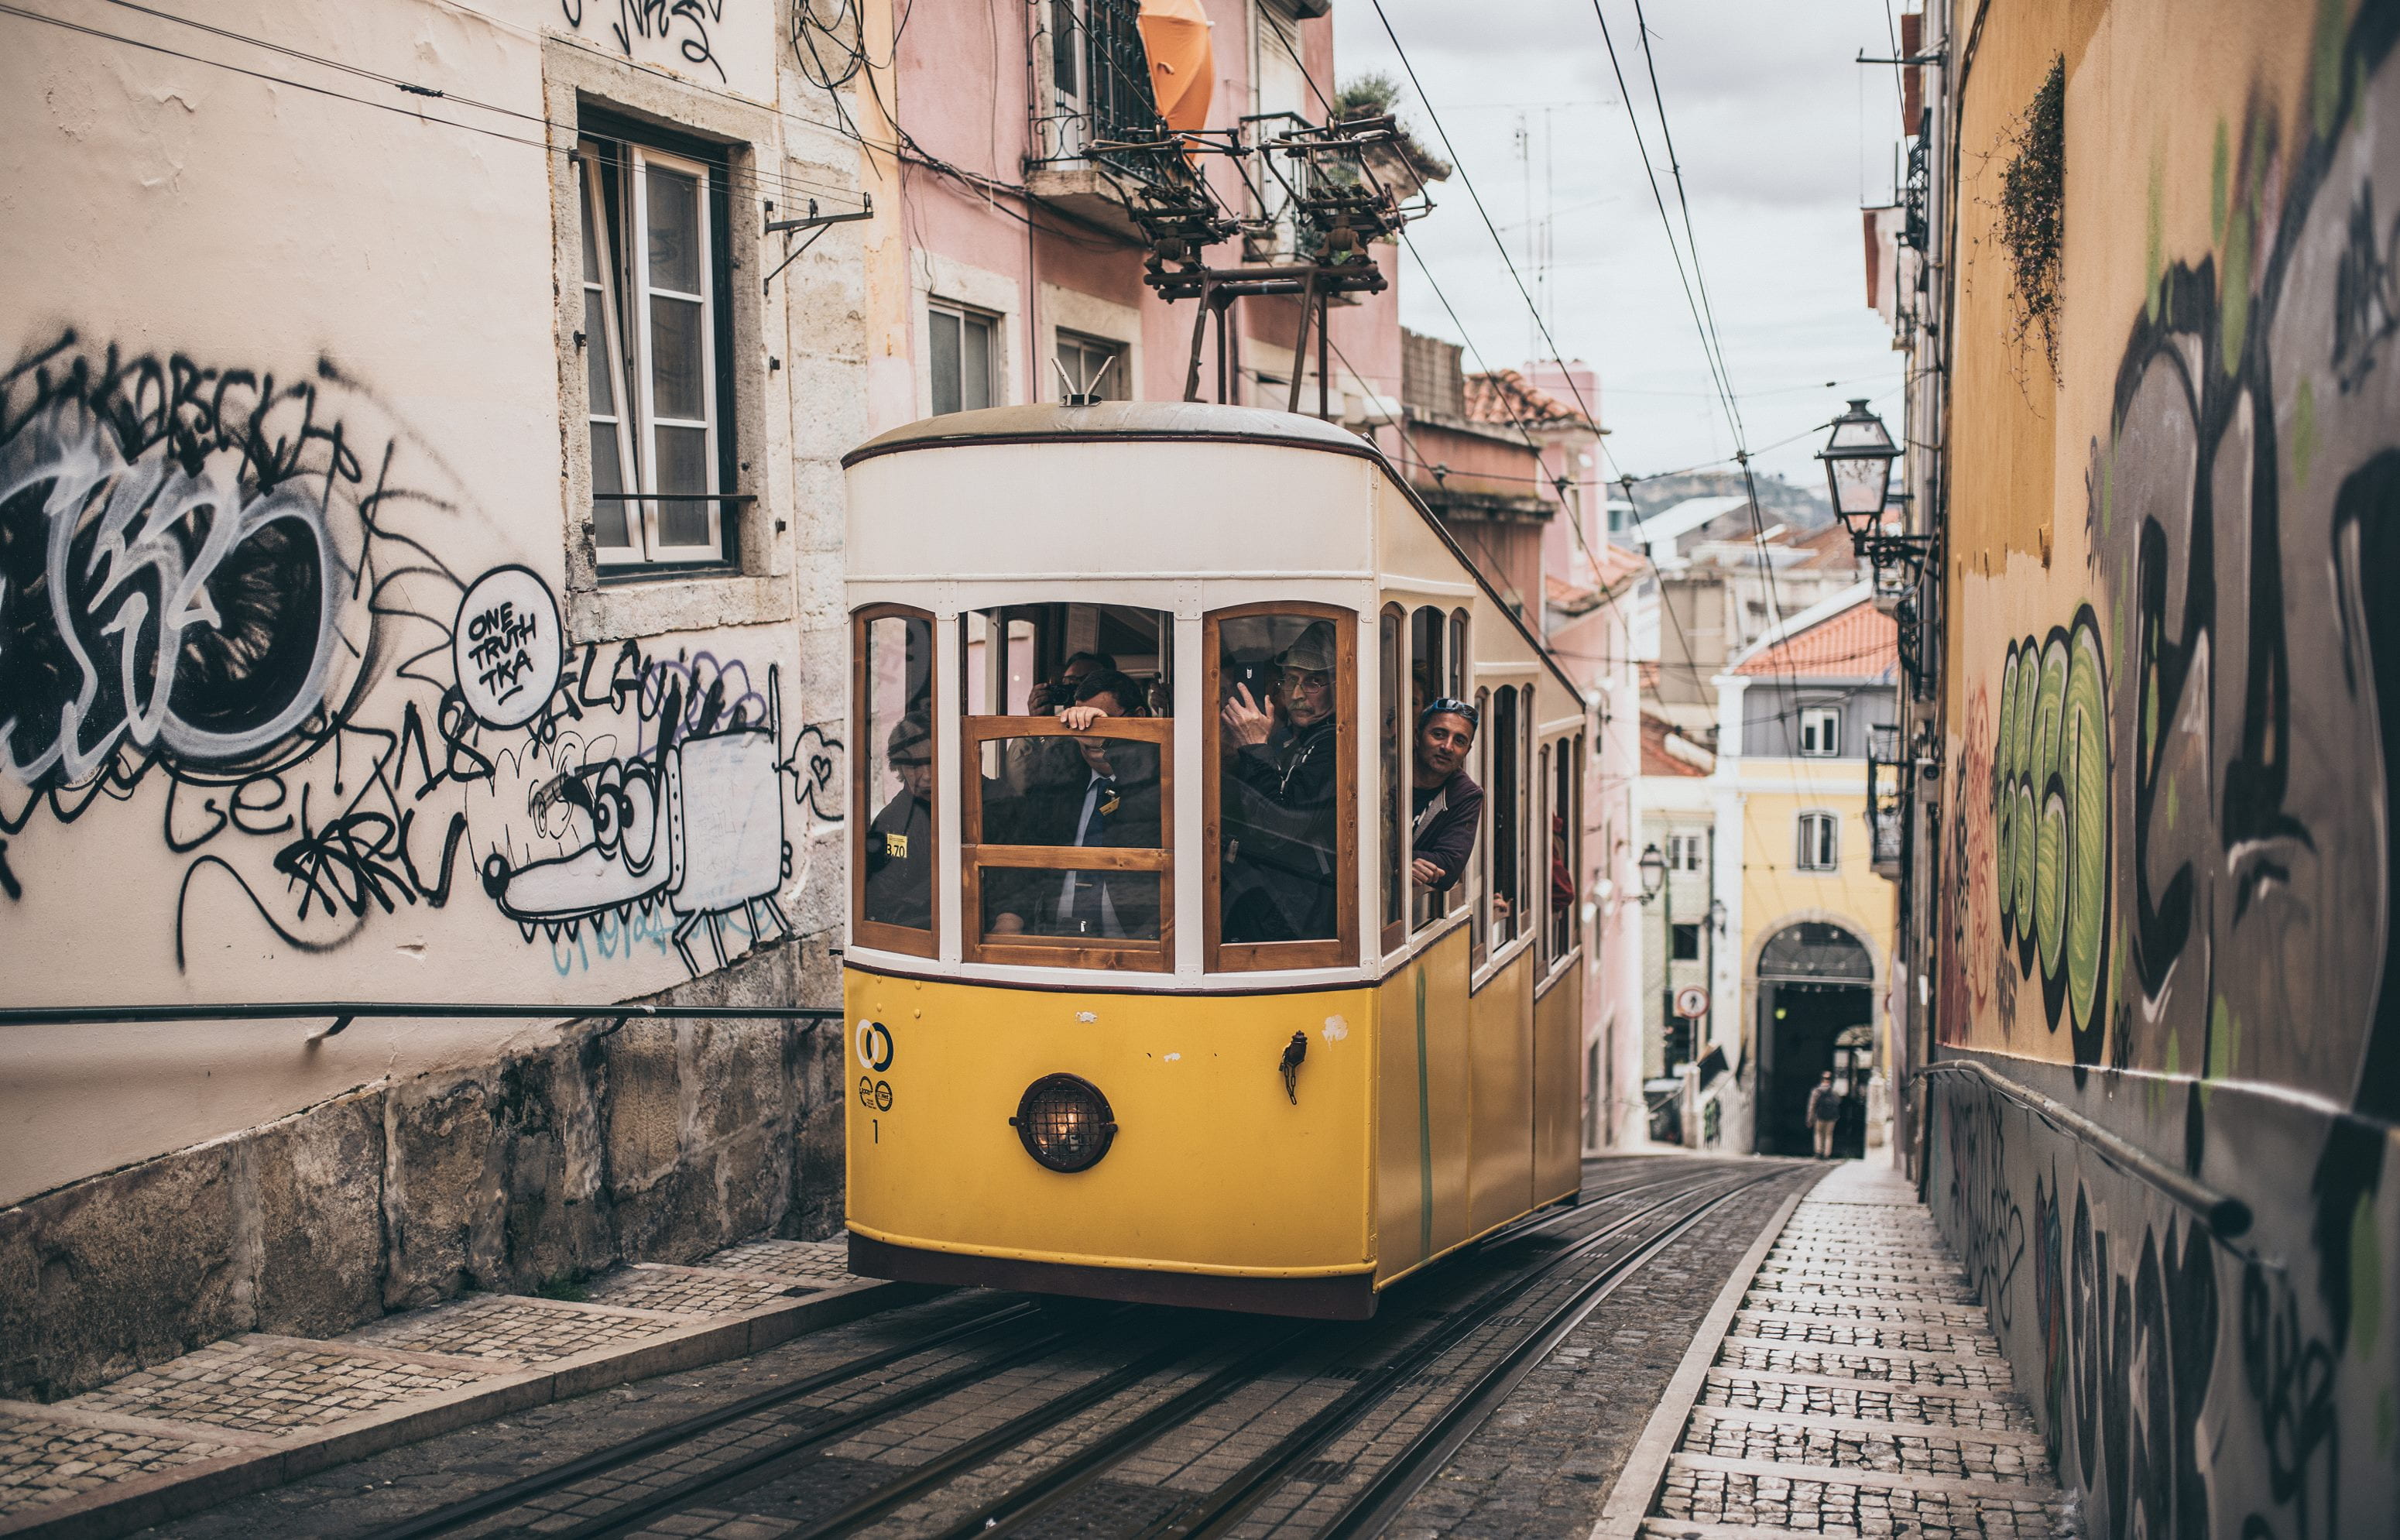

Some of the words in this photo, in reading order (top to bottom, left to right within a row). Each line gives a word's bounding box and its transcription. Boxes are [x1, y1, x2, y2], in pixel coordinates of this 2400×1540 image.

[468, 601, 513, 641] ONE
[468, 612, 537, 671] TRUTH
[478, 649, 534, 696] TKA
[873, 1119, 879, 1144] 1
